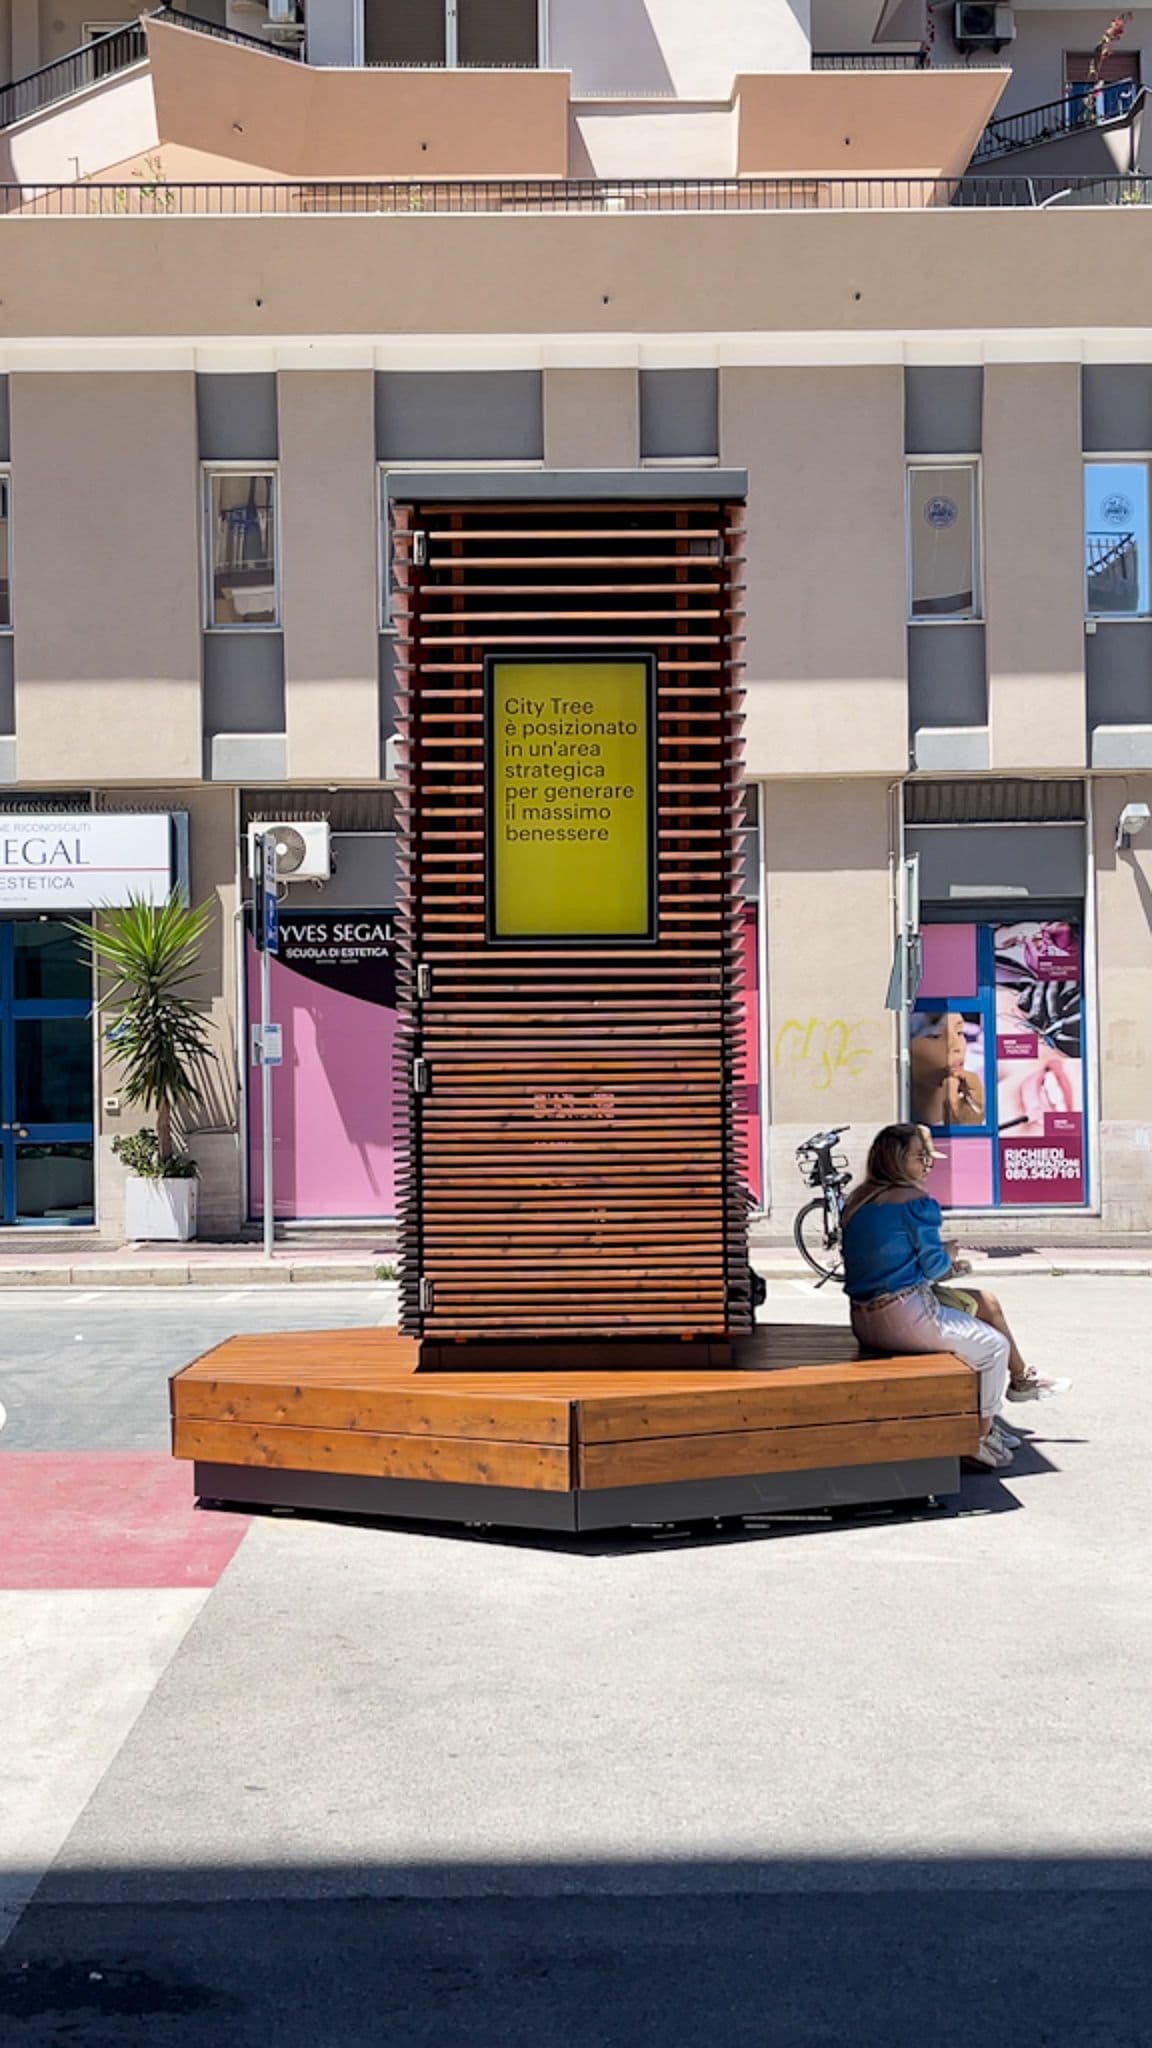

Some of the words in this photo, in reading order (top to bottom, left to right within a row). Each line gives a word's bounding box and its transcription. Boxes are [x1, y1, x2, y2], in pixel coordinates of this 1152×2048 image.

[505, 697, 545, 718] City
[551, 697, 594, 715] Tree
[505, 719, 517, 736] è
[523, 718, 638, 739] posizionato
[505, 740, 523, 757] in
[529, 740, 601, 757] un'area
[505, 761, 605, 782] strategica
[505, 785, 538, 802] per
[544, 784, 635, 803] generare
[505, 803, 515, 820] il
[523, 803, 611, 820] massimo
[505, 824, 609, 841] benessere
[280, 923, 328, 942] YVES
[332, 923, 395, 942] SEGAL
[285, 946, 327, 959] SCUOLA
[328, 946, 340, 958] DI
[341, 946, 390, 958] ESTETICA
